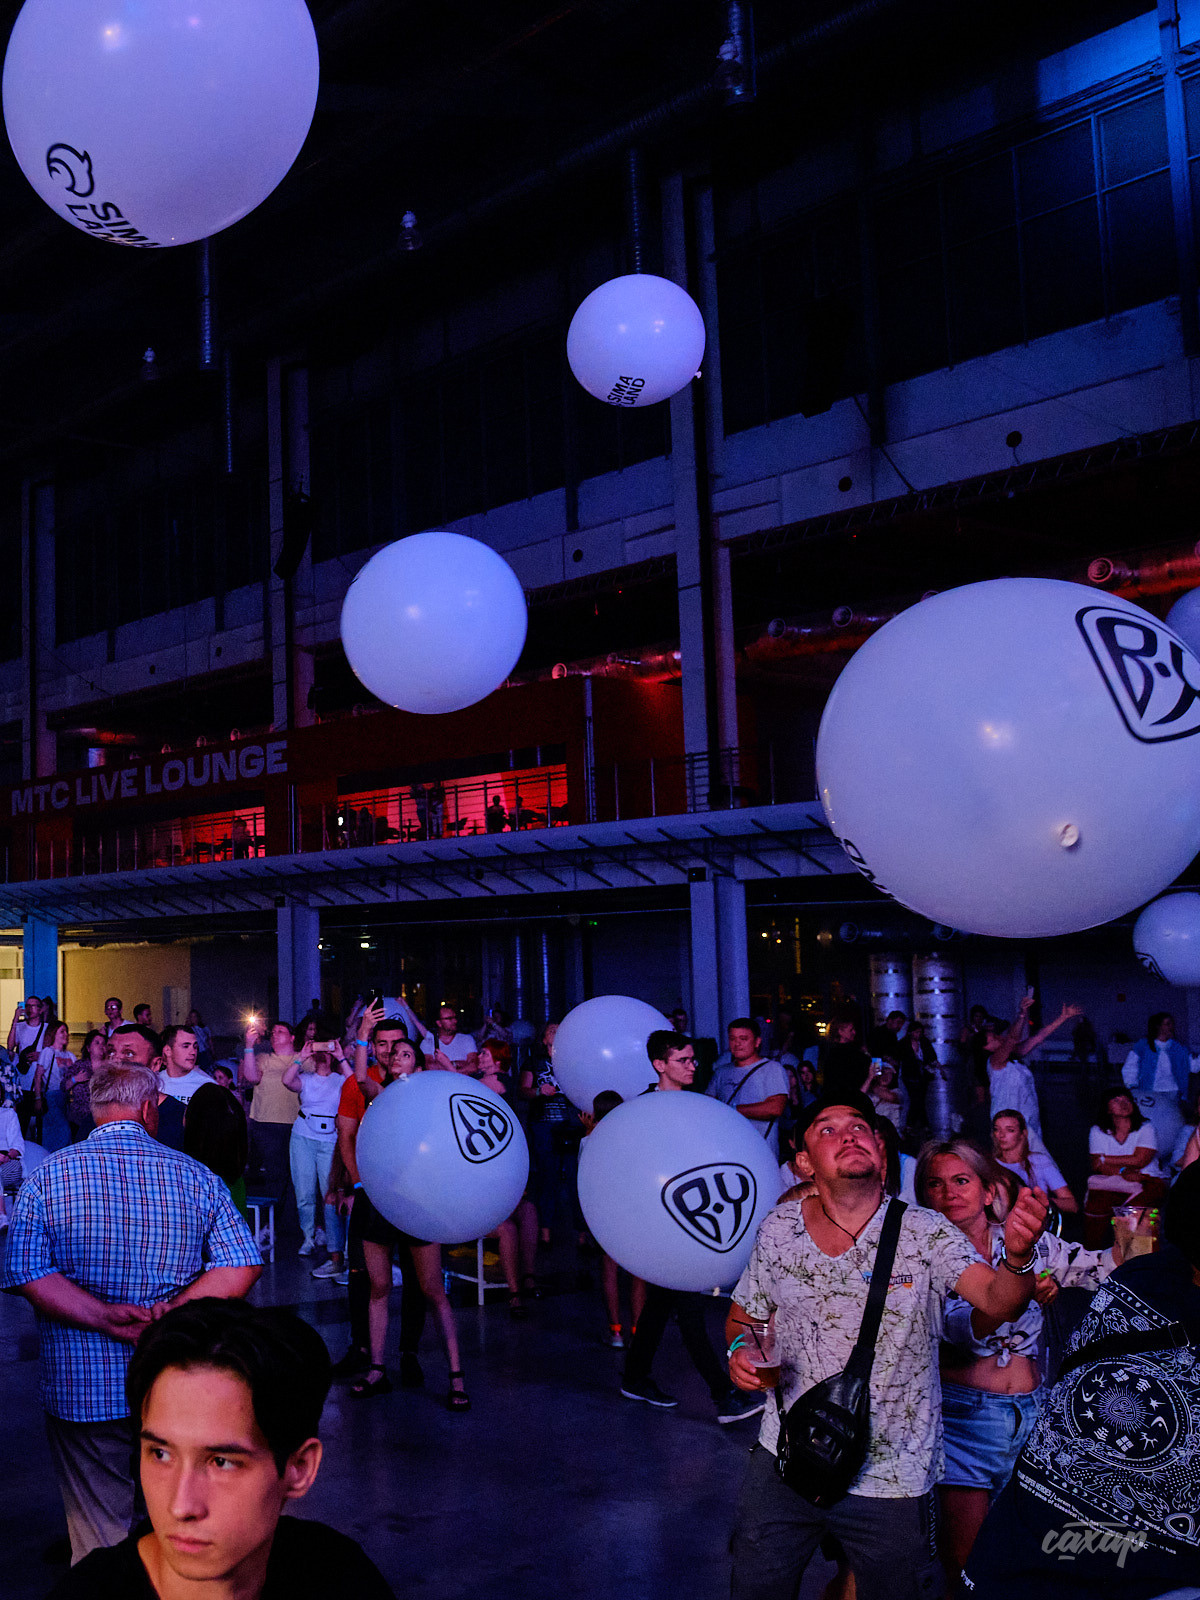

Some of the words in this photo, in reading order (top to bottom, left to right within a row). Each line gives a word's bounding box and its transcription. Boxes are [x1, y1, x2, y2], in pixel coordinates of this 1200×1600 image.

[607, 376, 633, 402] SIMA
[620, 378, 645, 405] LAND
[75, 767, 138, 805] LIVE
[145, 740, 288, 795] LOUNGE
